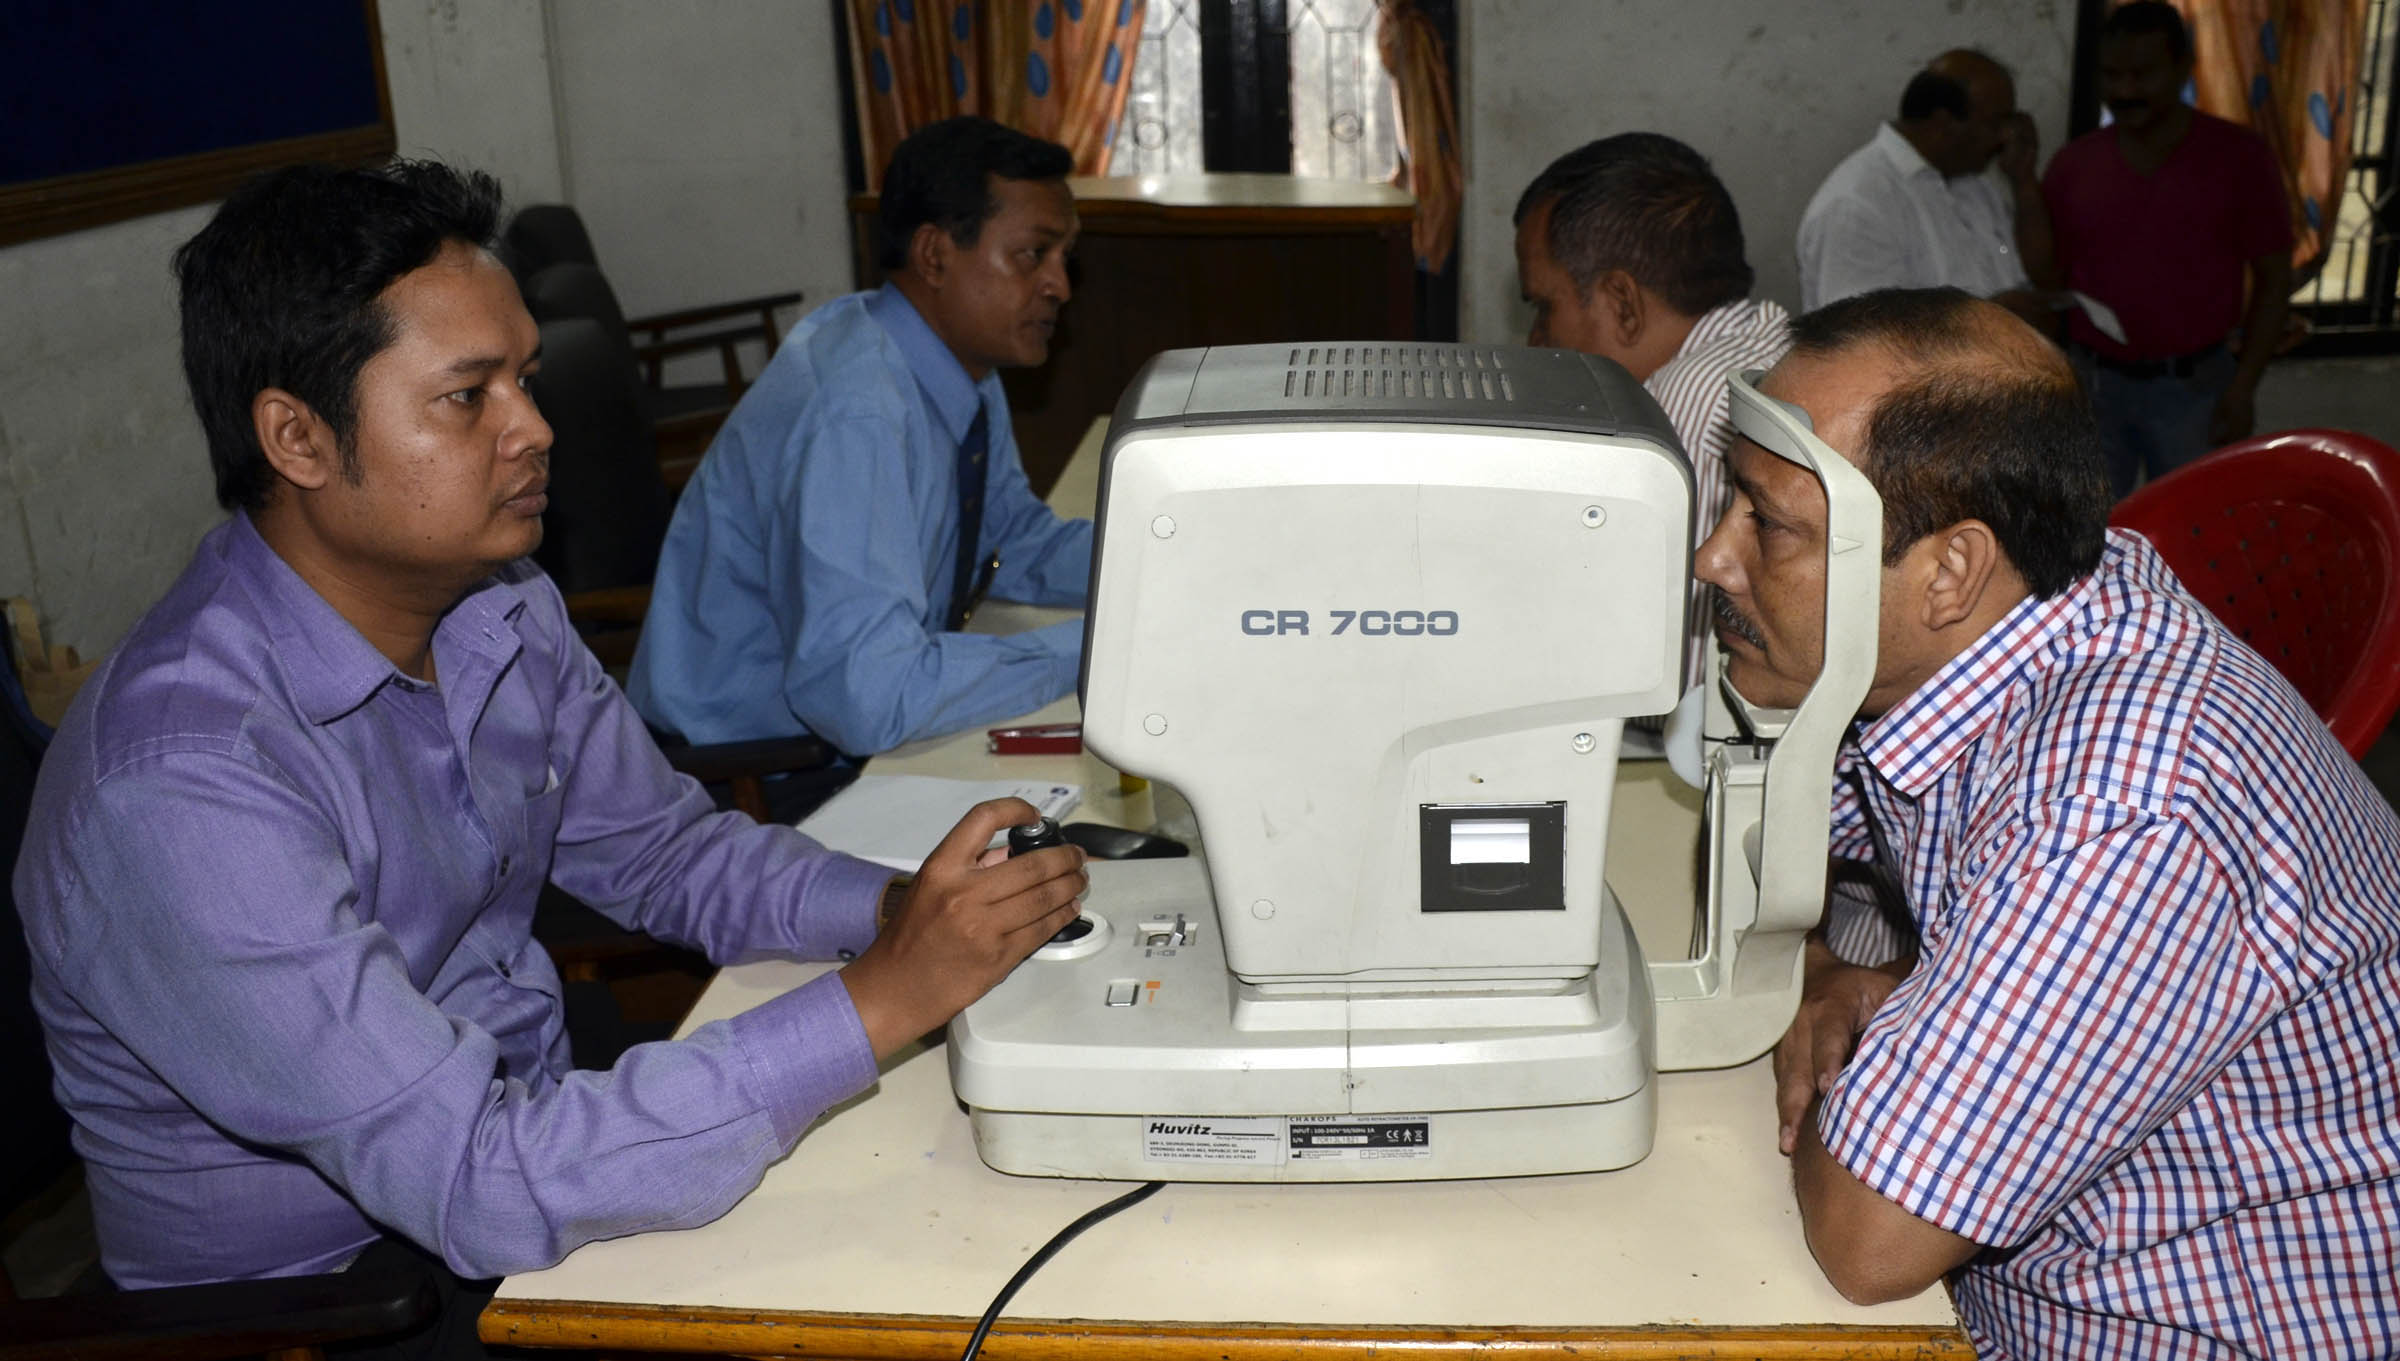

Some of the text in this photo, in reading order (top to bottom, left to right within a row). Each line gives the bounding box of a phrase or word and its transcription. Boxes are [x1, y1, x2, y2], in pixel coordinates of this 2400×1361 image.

[1241, 610, 1458, 636] CR 7000
[1149, 1122, 1212, 1135] Huvitz
[1386, 1129, 1400, 1139] CE
